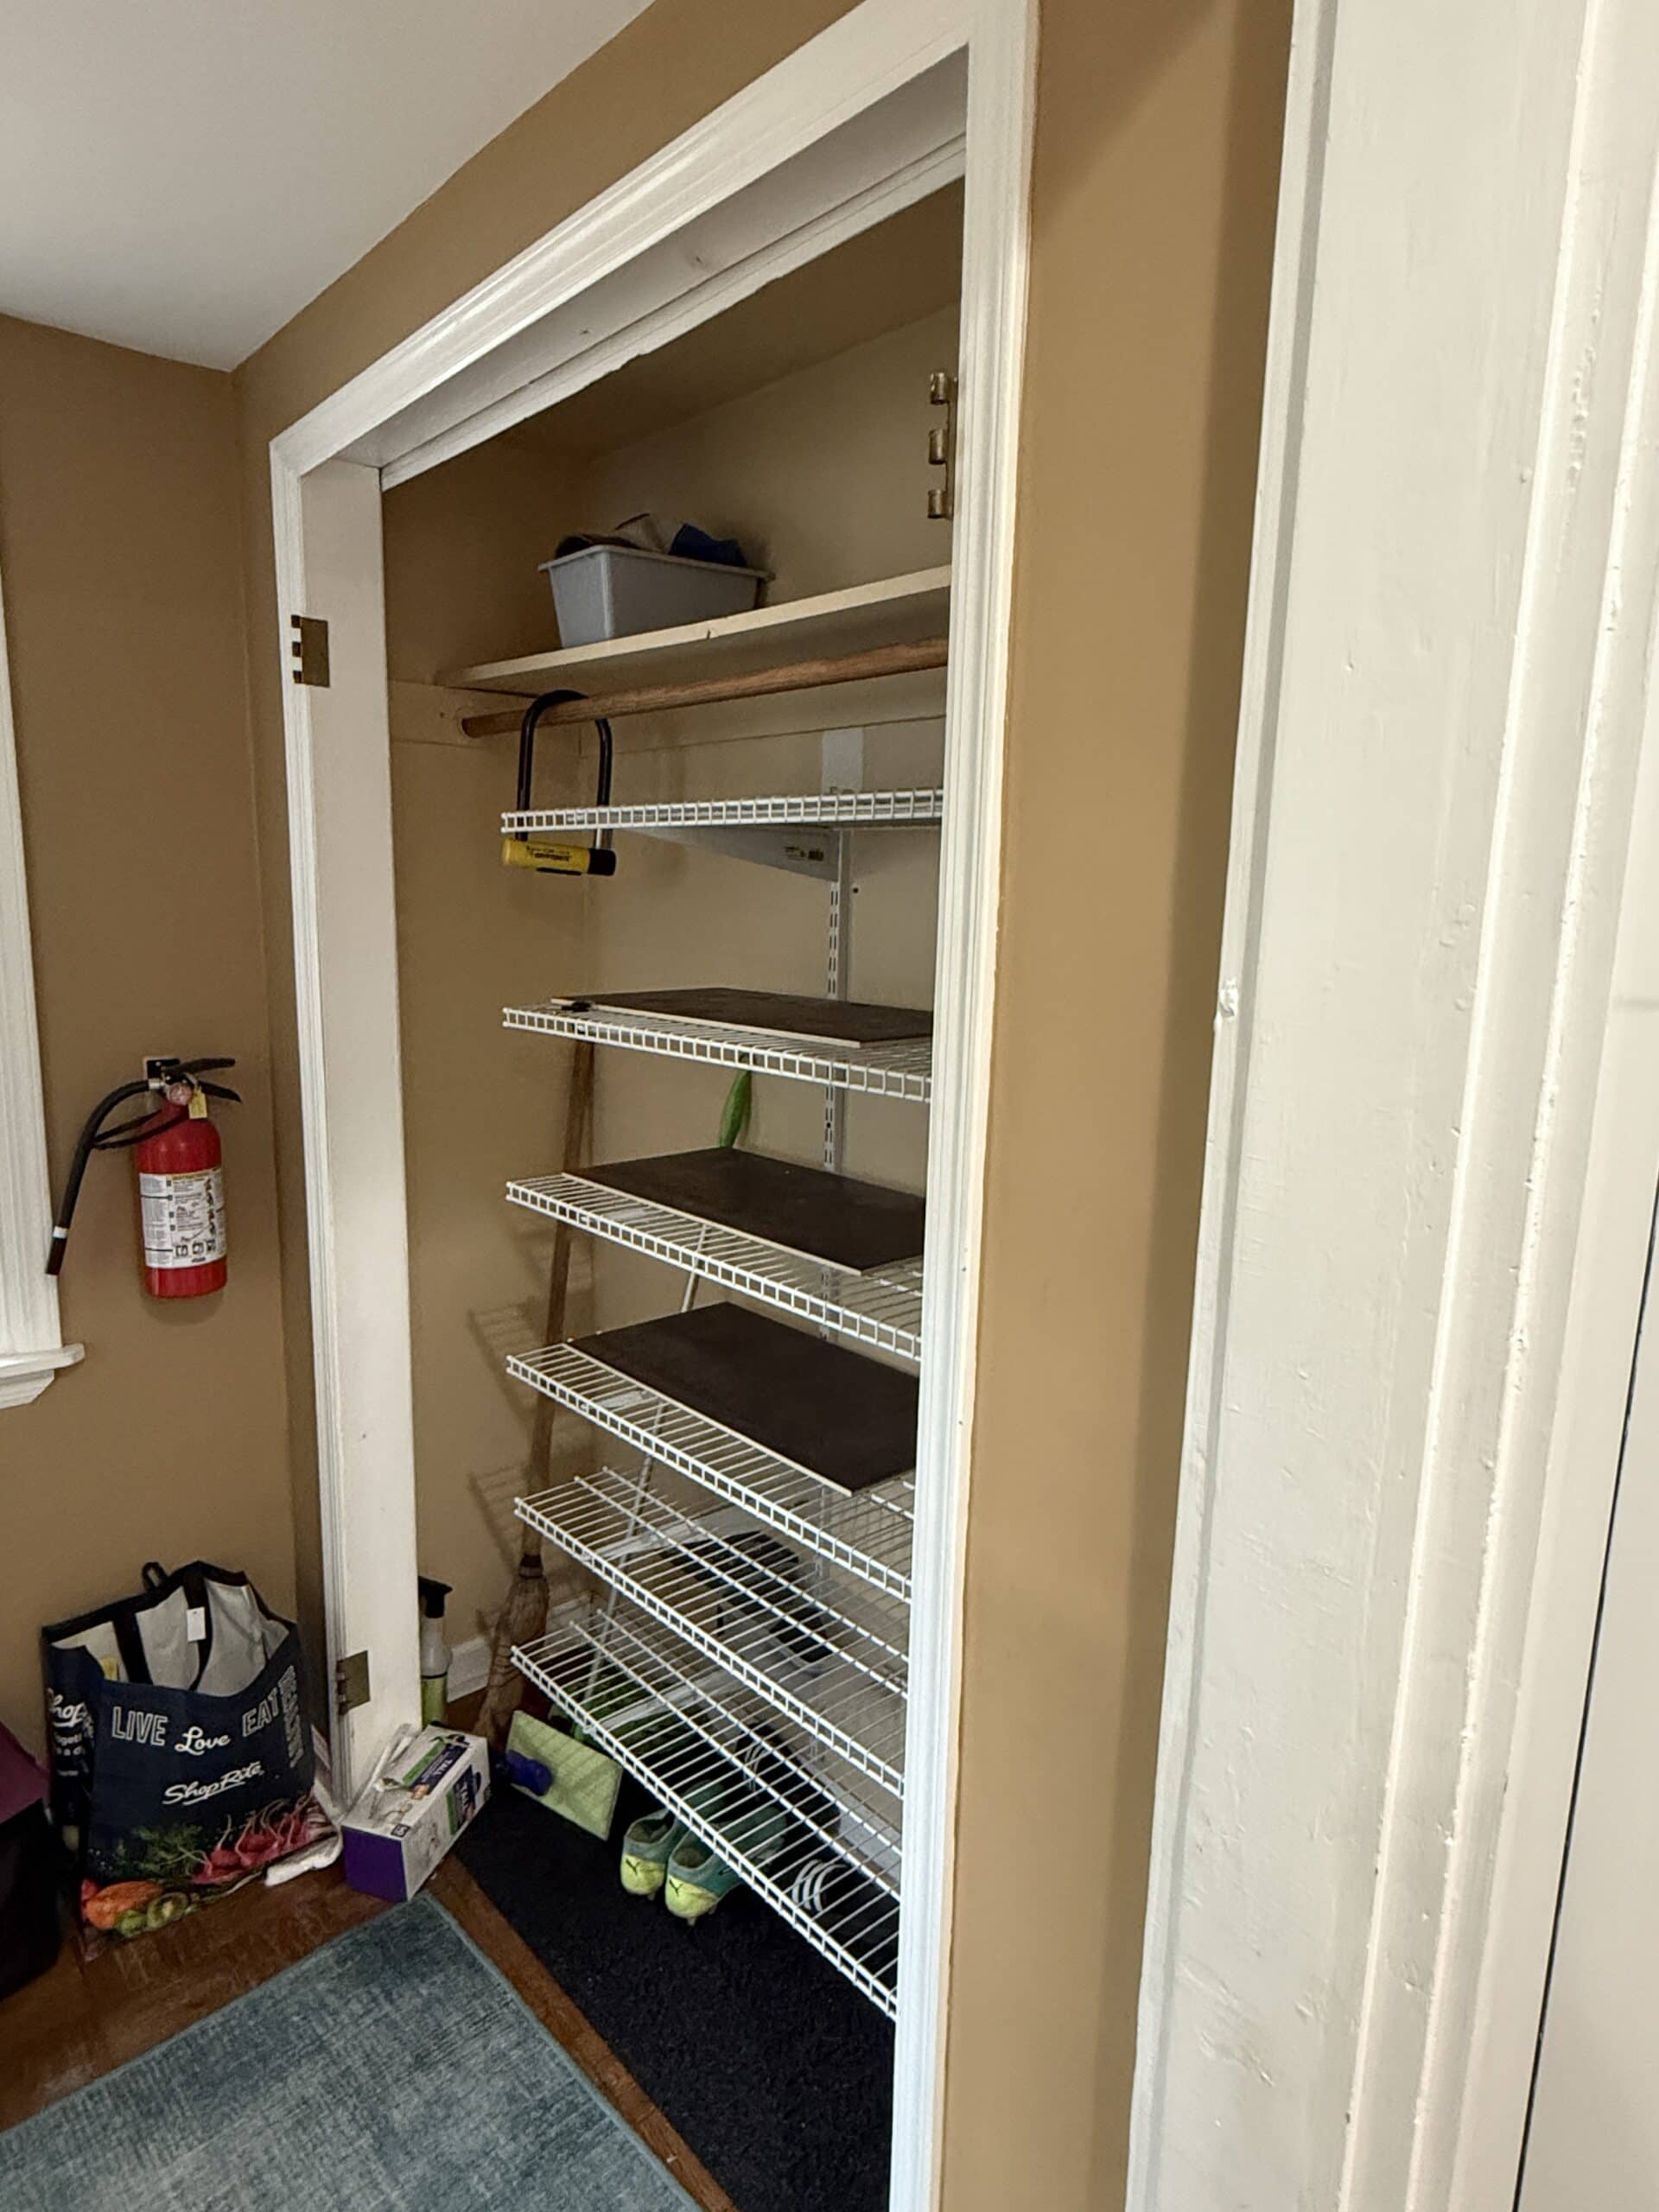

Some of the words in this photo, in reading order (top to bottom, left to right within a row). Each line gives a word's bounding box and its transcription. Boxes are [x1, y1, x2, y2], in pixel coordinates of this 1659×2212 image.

[111, 1706, 168, 1746] LIVE
[175, 1726, 232, 1756] Love
[242, 1686, 279, 1738] EAT
[162, 1760, 265, 1806] ShopRite
